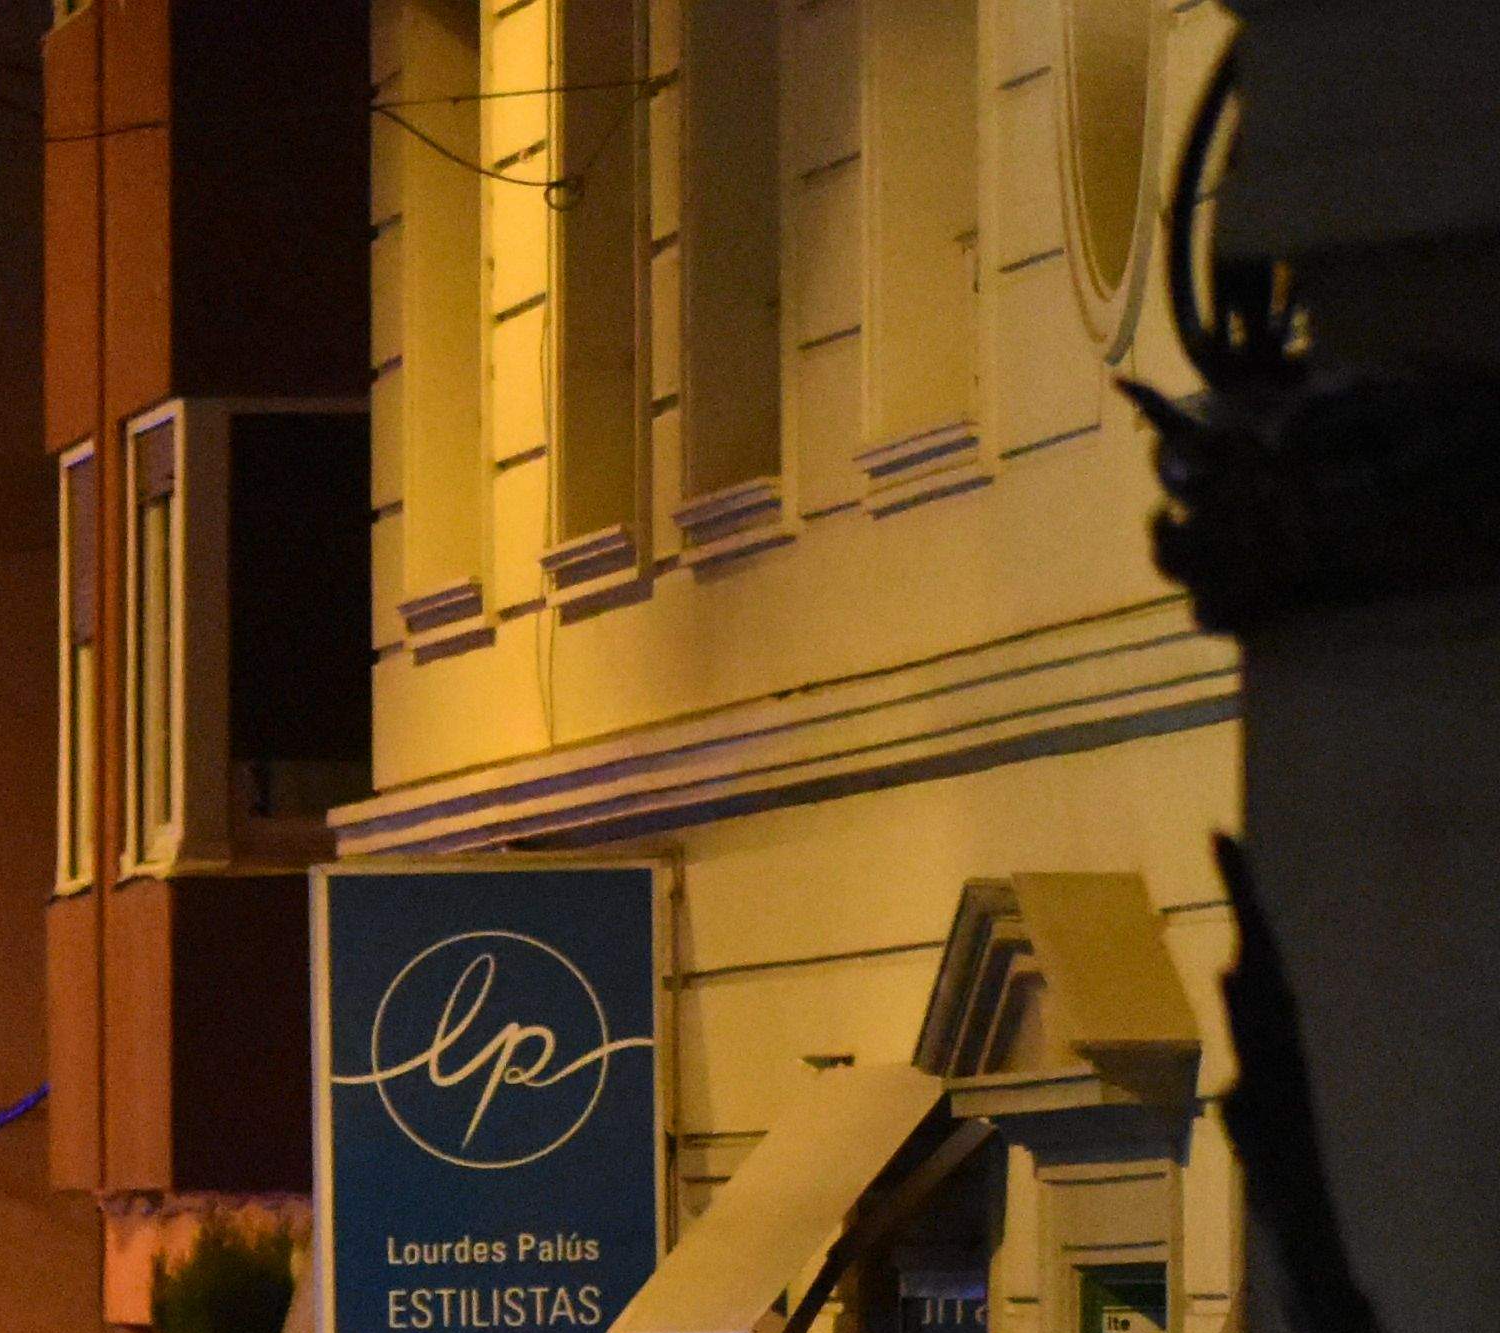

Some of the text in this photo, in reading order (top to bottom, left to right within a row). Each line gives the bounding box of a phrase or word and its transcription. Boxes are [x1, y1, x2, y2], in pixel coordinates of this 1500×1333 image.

[386, 1231, 600, 1265] Lourdes Palús
[387, 1284, 602, 1329] ESTILISTAS
